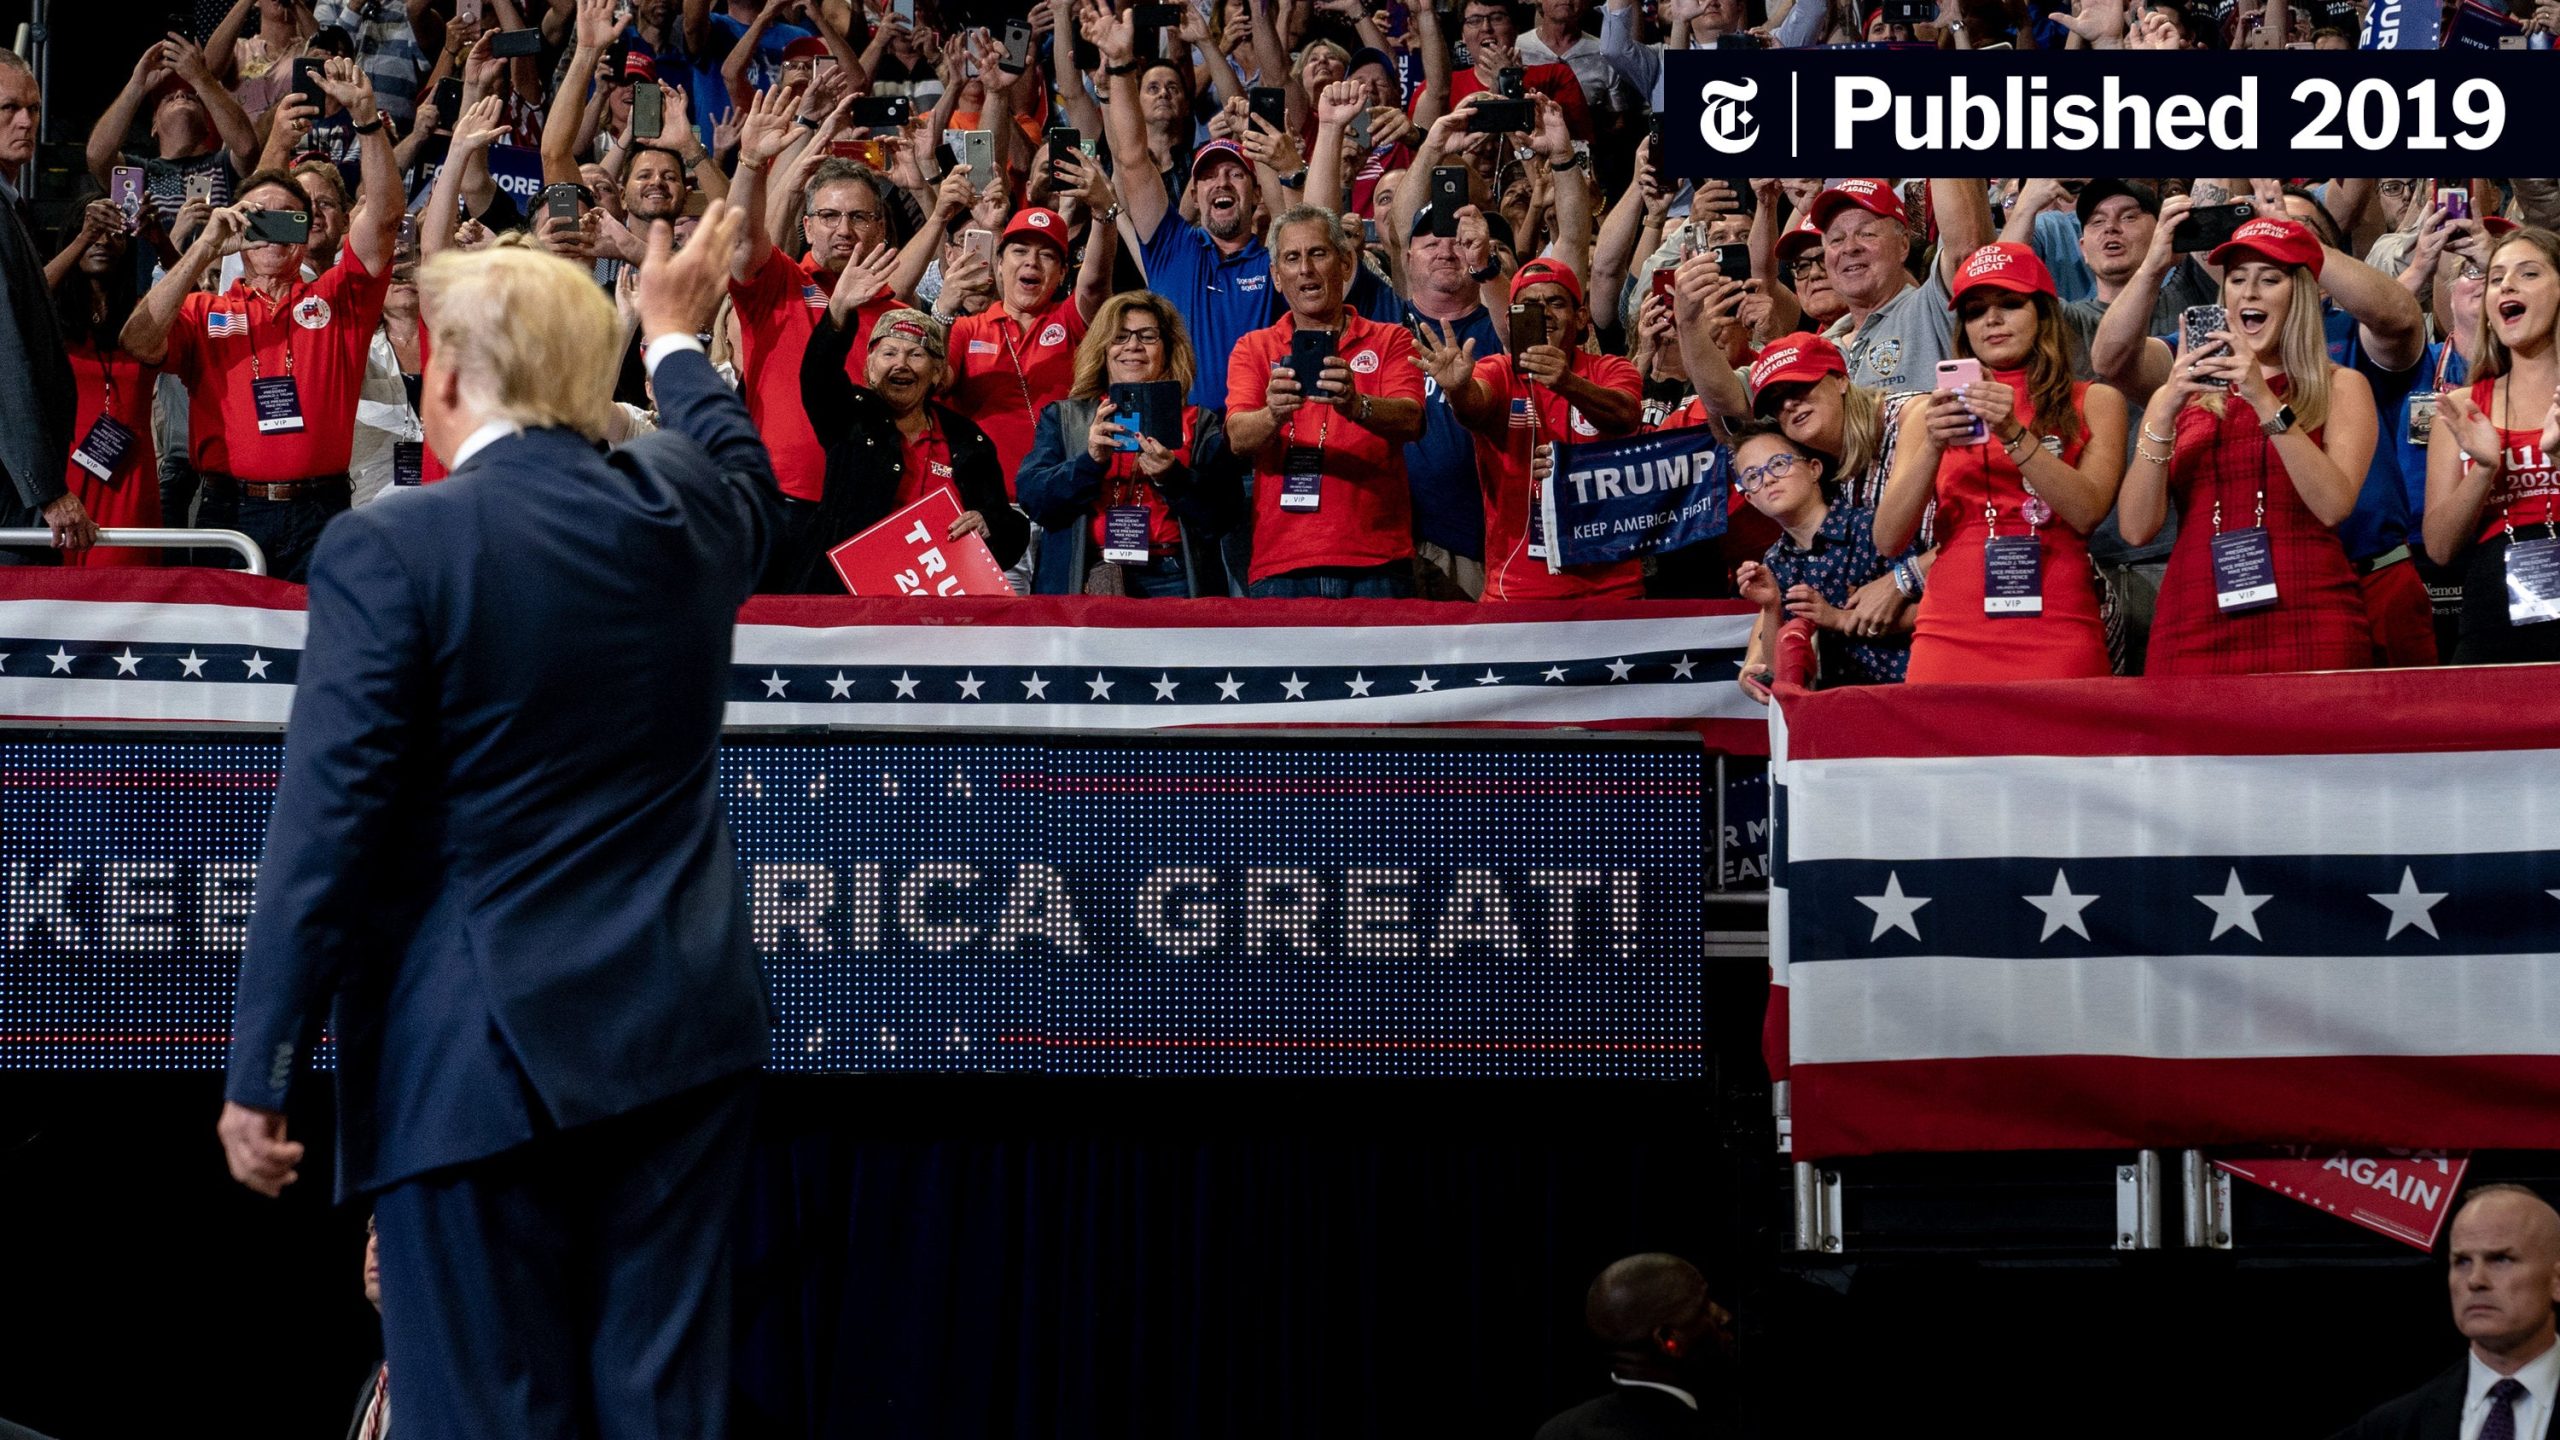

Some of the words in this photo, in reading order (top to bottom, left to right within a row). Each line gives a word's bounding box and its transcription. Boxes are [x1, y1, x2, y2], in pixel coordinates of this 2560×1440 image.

[1968, 262, 2006, 277] GREAT
[1771, 354, 1798, 371] AGAIN
[86, 458, 99, 469] VIP
[1568, 450, 1716, 504] TRUMP
[1574, 521, 1608, 539] KEEP
[1613, 510, 1678, 533] AMERICA
[1682, 496, 1712, 520] FIRST!
[904, 519, 967, 597] TRU
[2238, 590, 2255, 599] VIP
[2422, 582, 2464, 597] Nemou
[2004, 599, 2022, 607] VIP
[8, 861, 258, 951] KEE
[751, 862, 1091, 955] RICA
[1138, 866, 1638, 959] GREAT!
[2322, 1151, 2442, 1212] AGAIN
